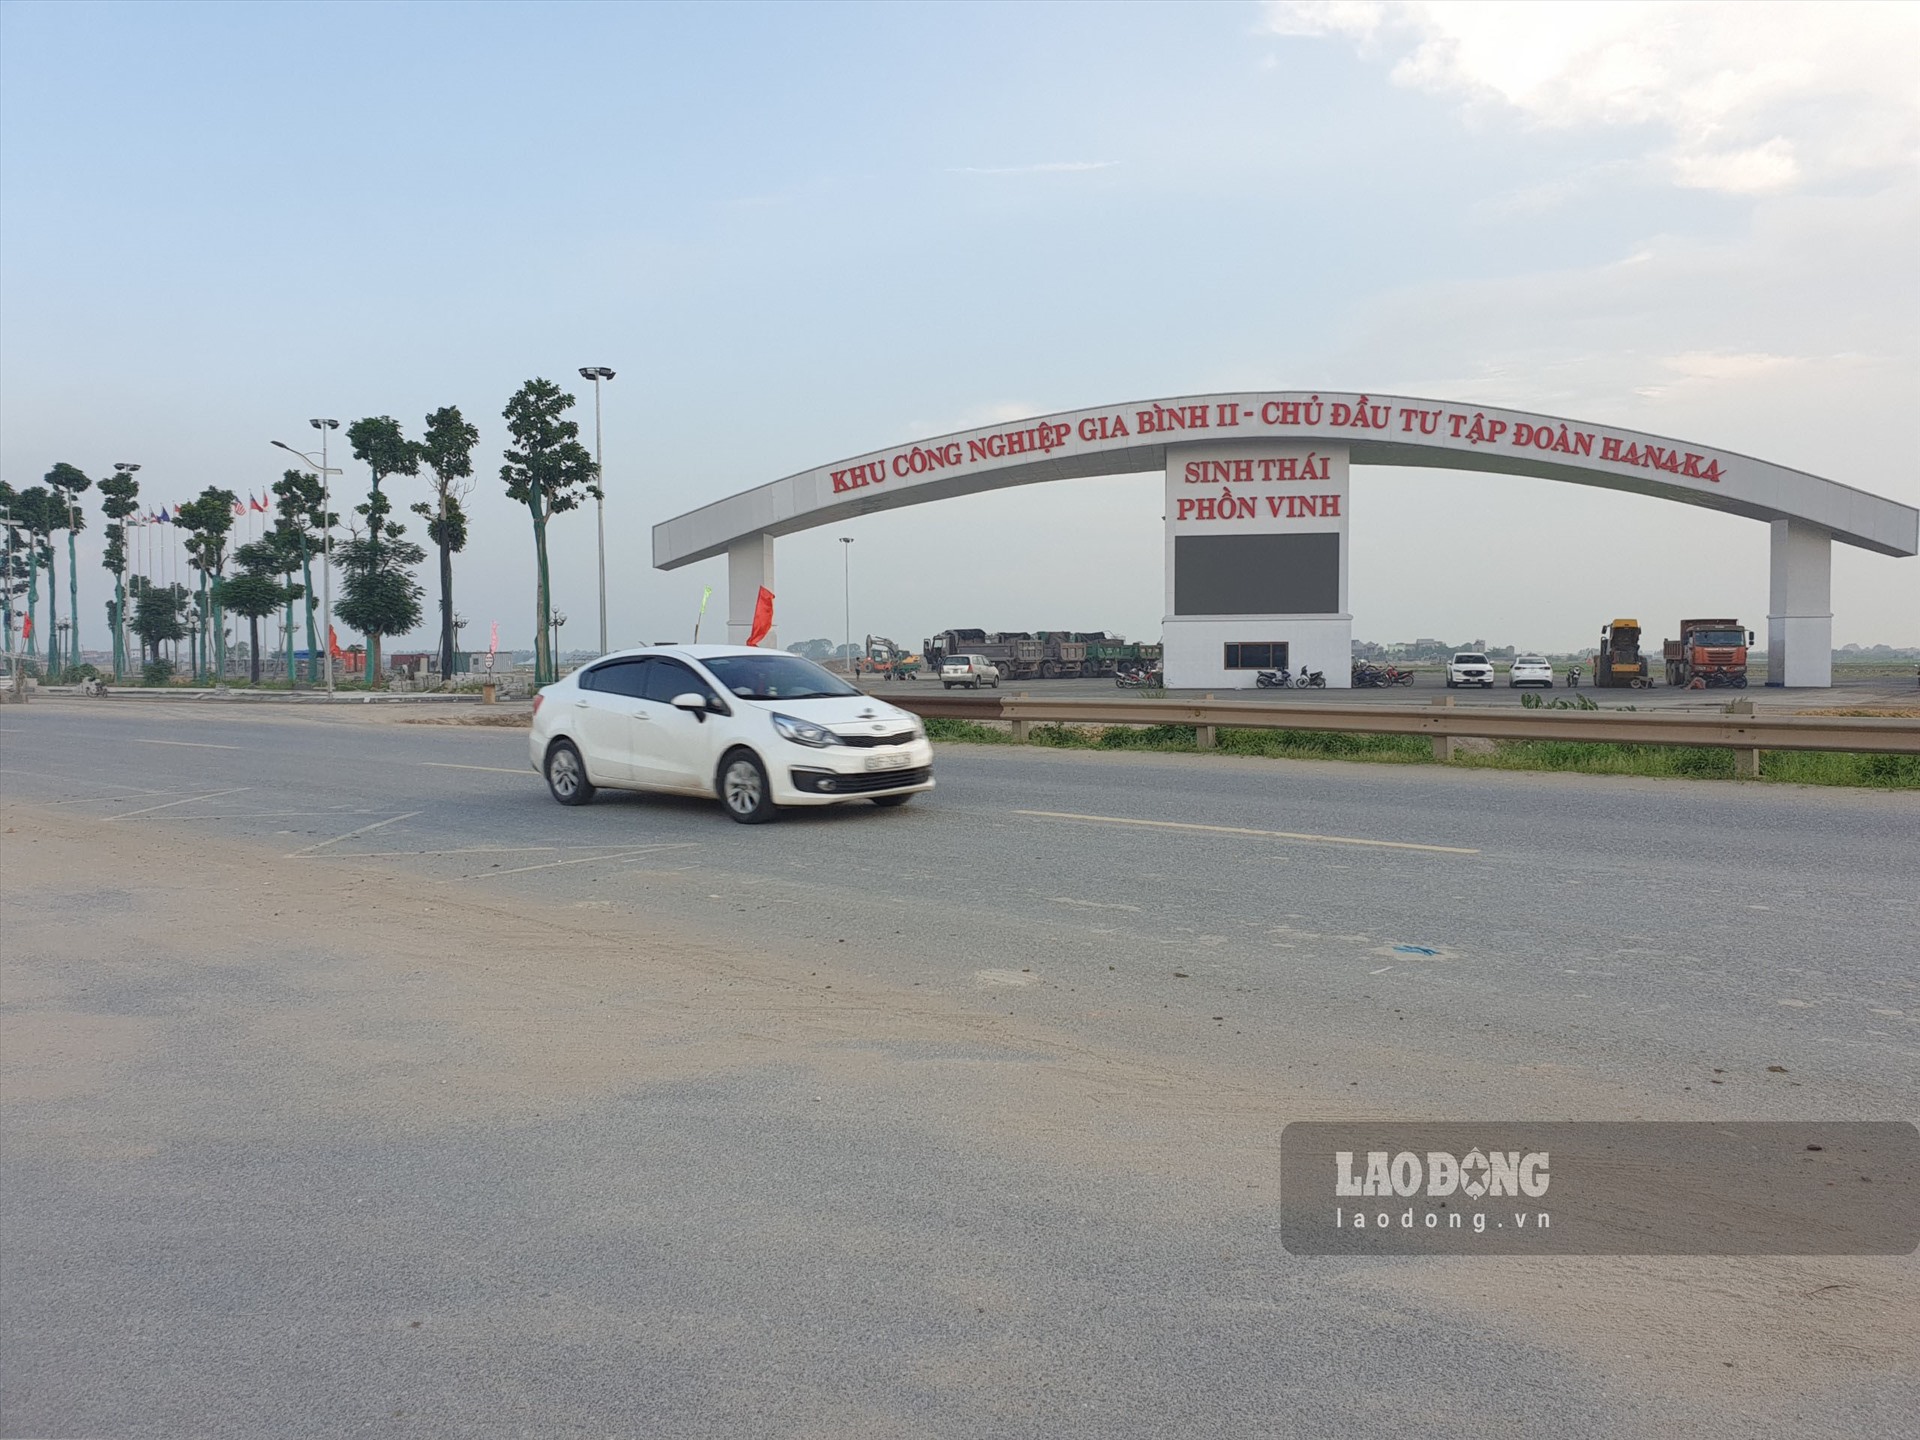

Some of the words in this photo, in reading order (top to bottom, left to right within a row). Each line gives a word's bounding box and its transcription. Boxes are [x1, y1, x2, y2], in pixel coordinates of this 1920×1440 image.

[830, 459, 886, 494] KHU
[892, 443, 963, 478] CÔNG
[967, 421, 1071, 463] NGHIỆP
[1077, 415, 1130, 443] GIA
[1136, 402, 1209, 434] BÌNH
[1217, 403, 1239, 428] II
[1260, 395, 1323, 426] CHỦ
[1330, 394, 1392, 430] ĐẦU
[1399, 407, 1443, 435] TƯ
[1447, 412, 1508, 445] TẬP
[1512, 422, 1596, 457] ĐOÀN
[1600, 436, 1727, 483] HANAKA
[1184, 458, 1253, 484] SINH
[1257, 452, 1330, 482] THÁI
[1177, 486, 1257, 521] PHỒN
[1265, 494, 1341, 519] VINH
